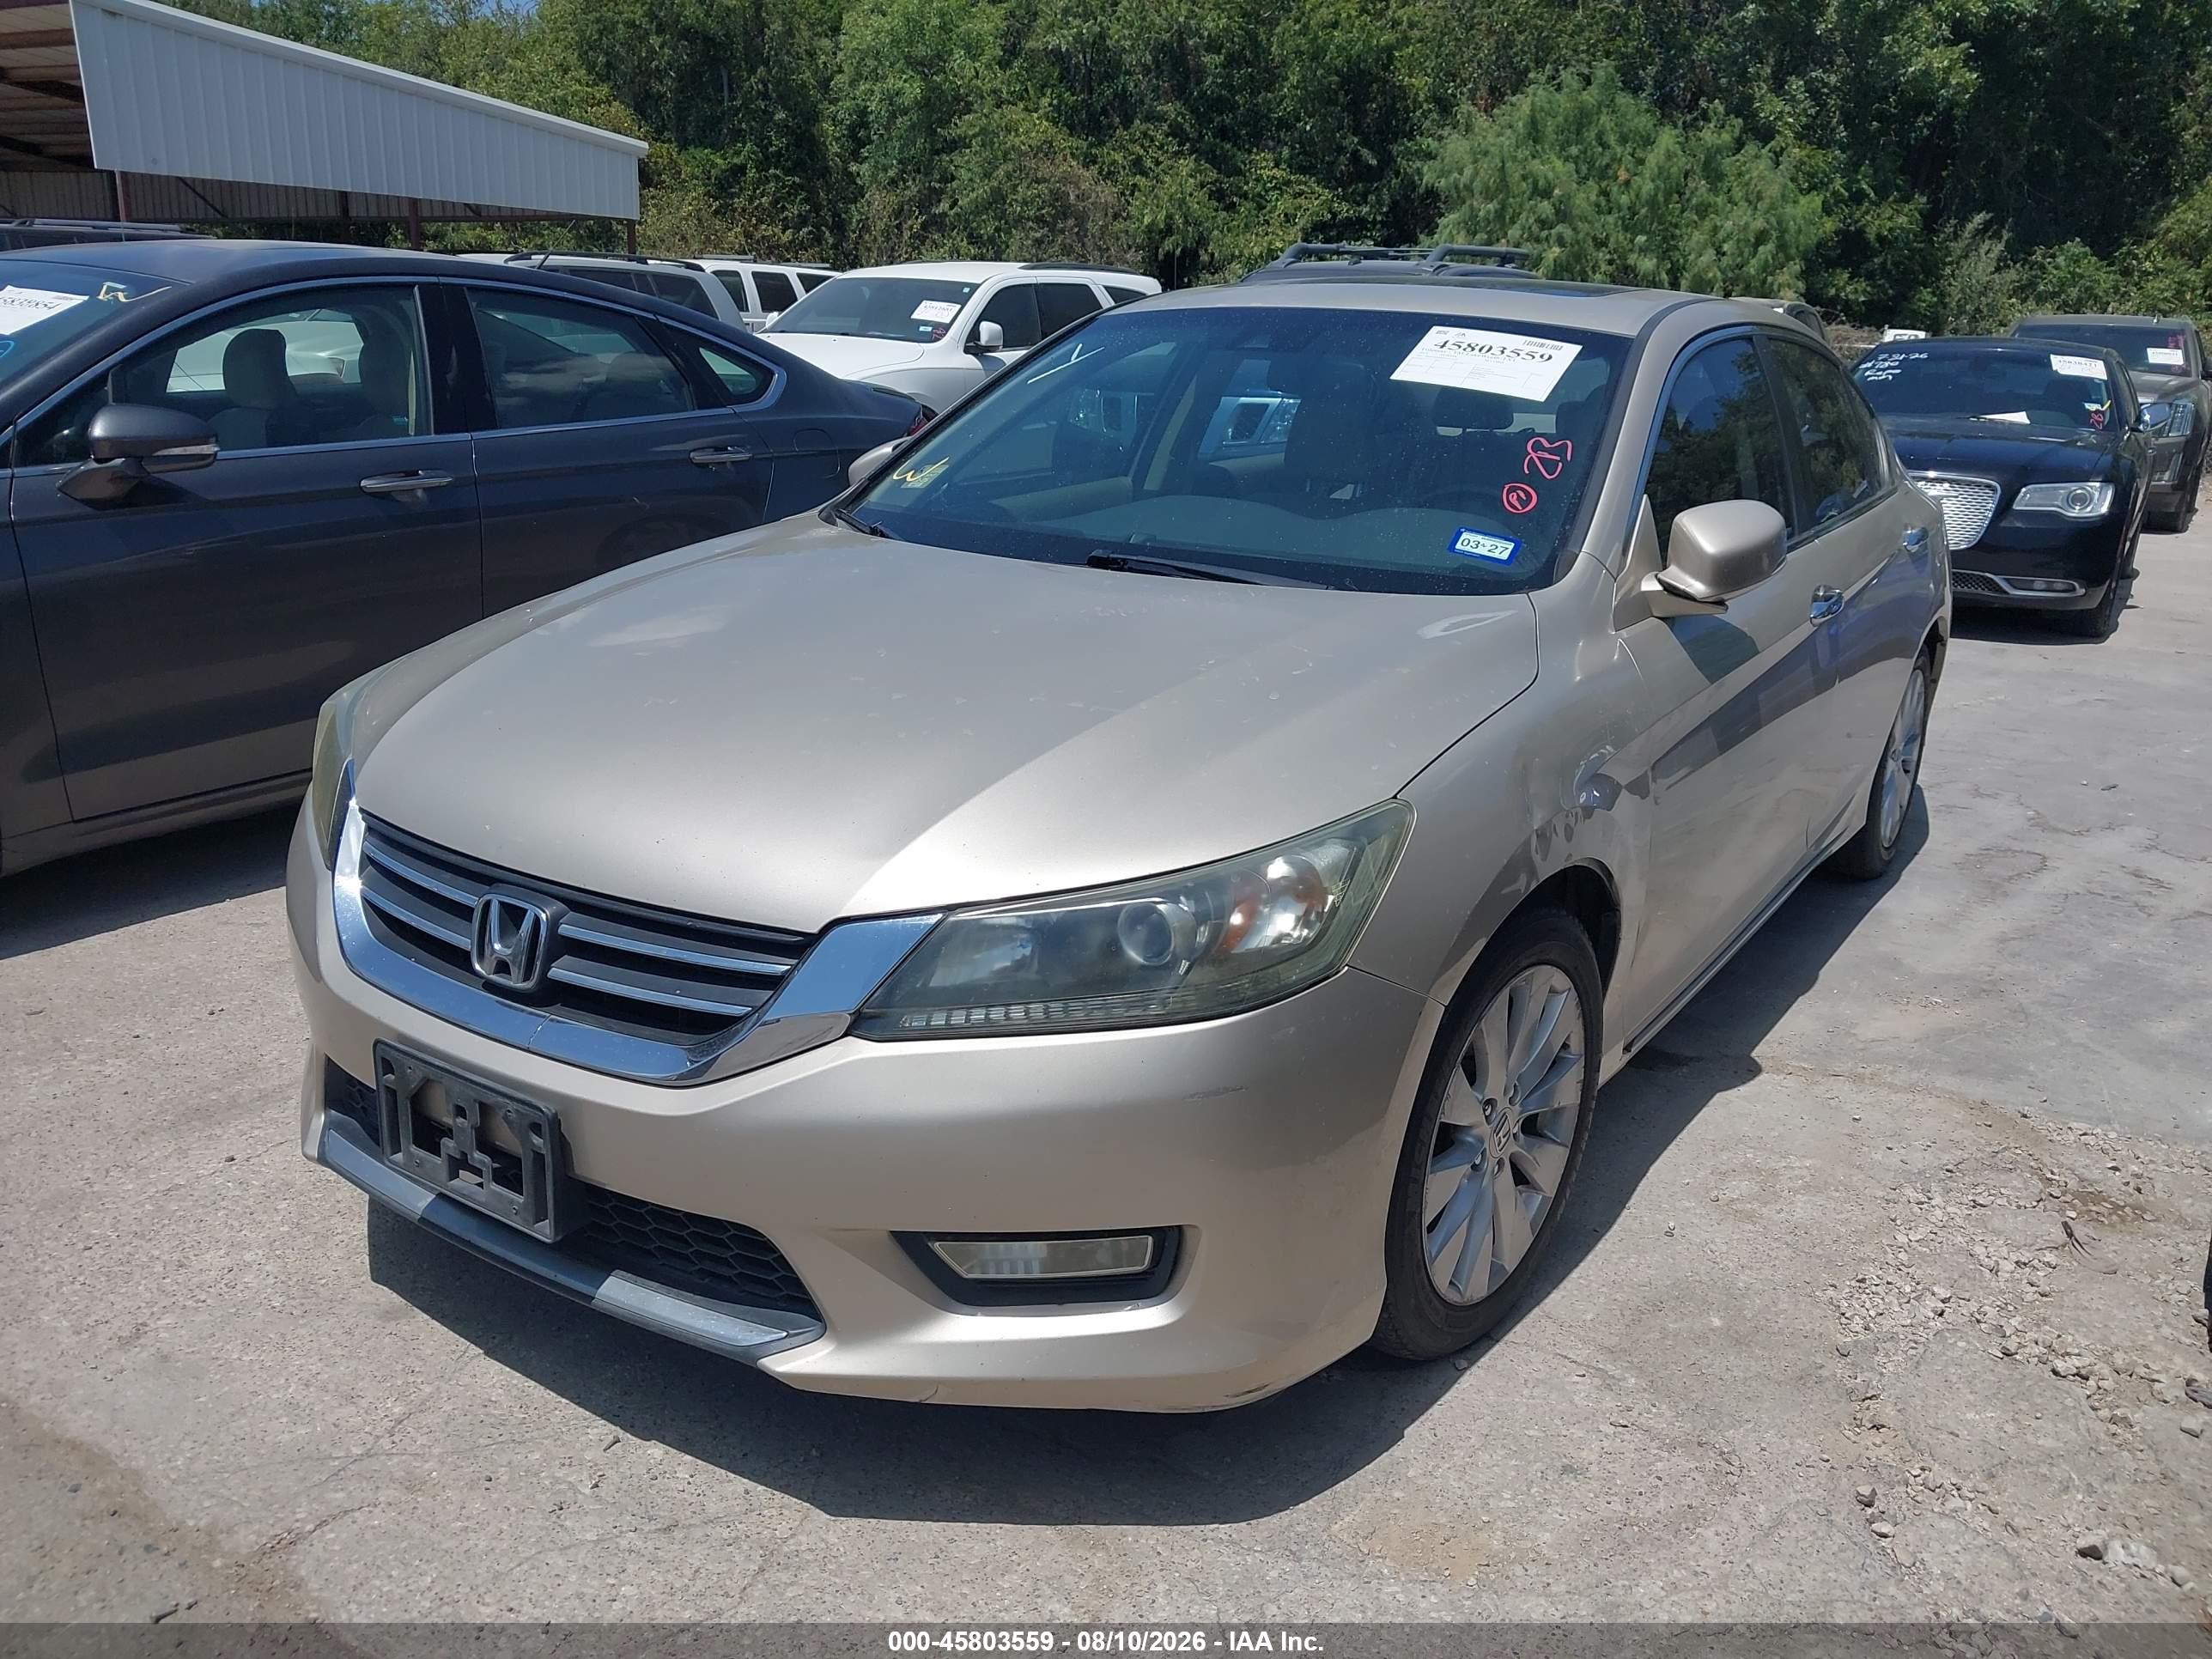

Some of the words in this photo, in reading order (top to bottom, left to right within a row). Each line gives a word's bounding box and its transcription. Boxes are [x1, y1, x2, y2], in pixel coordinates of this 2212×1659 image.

[1433, 338, 1554, 364] 45803559
[1460, 537, 1480, 550] 03
[1486, 544, 1510, 556] 27
